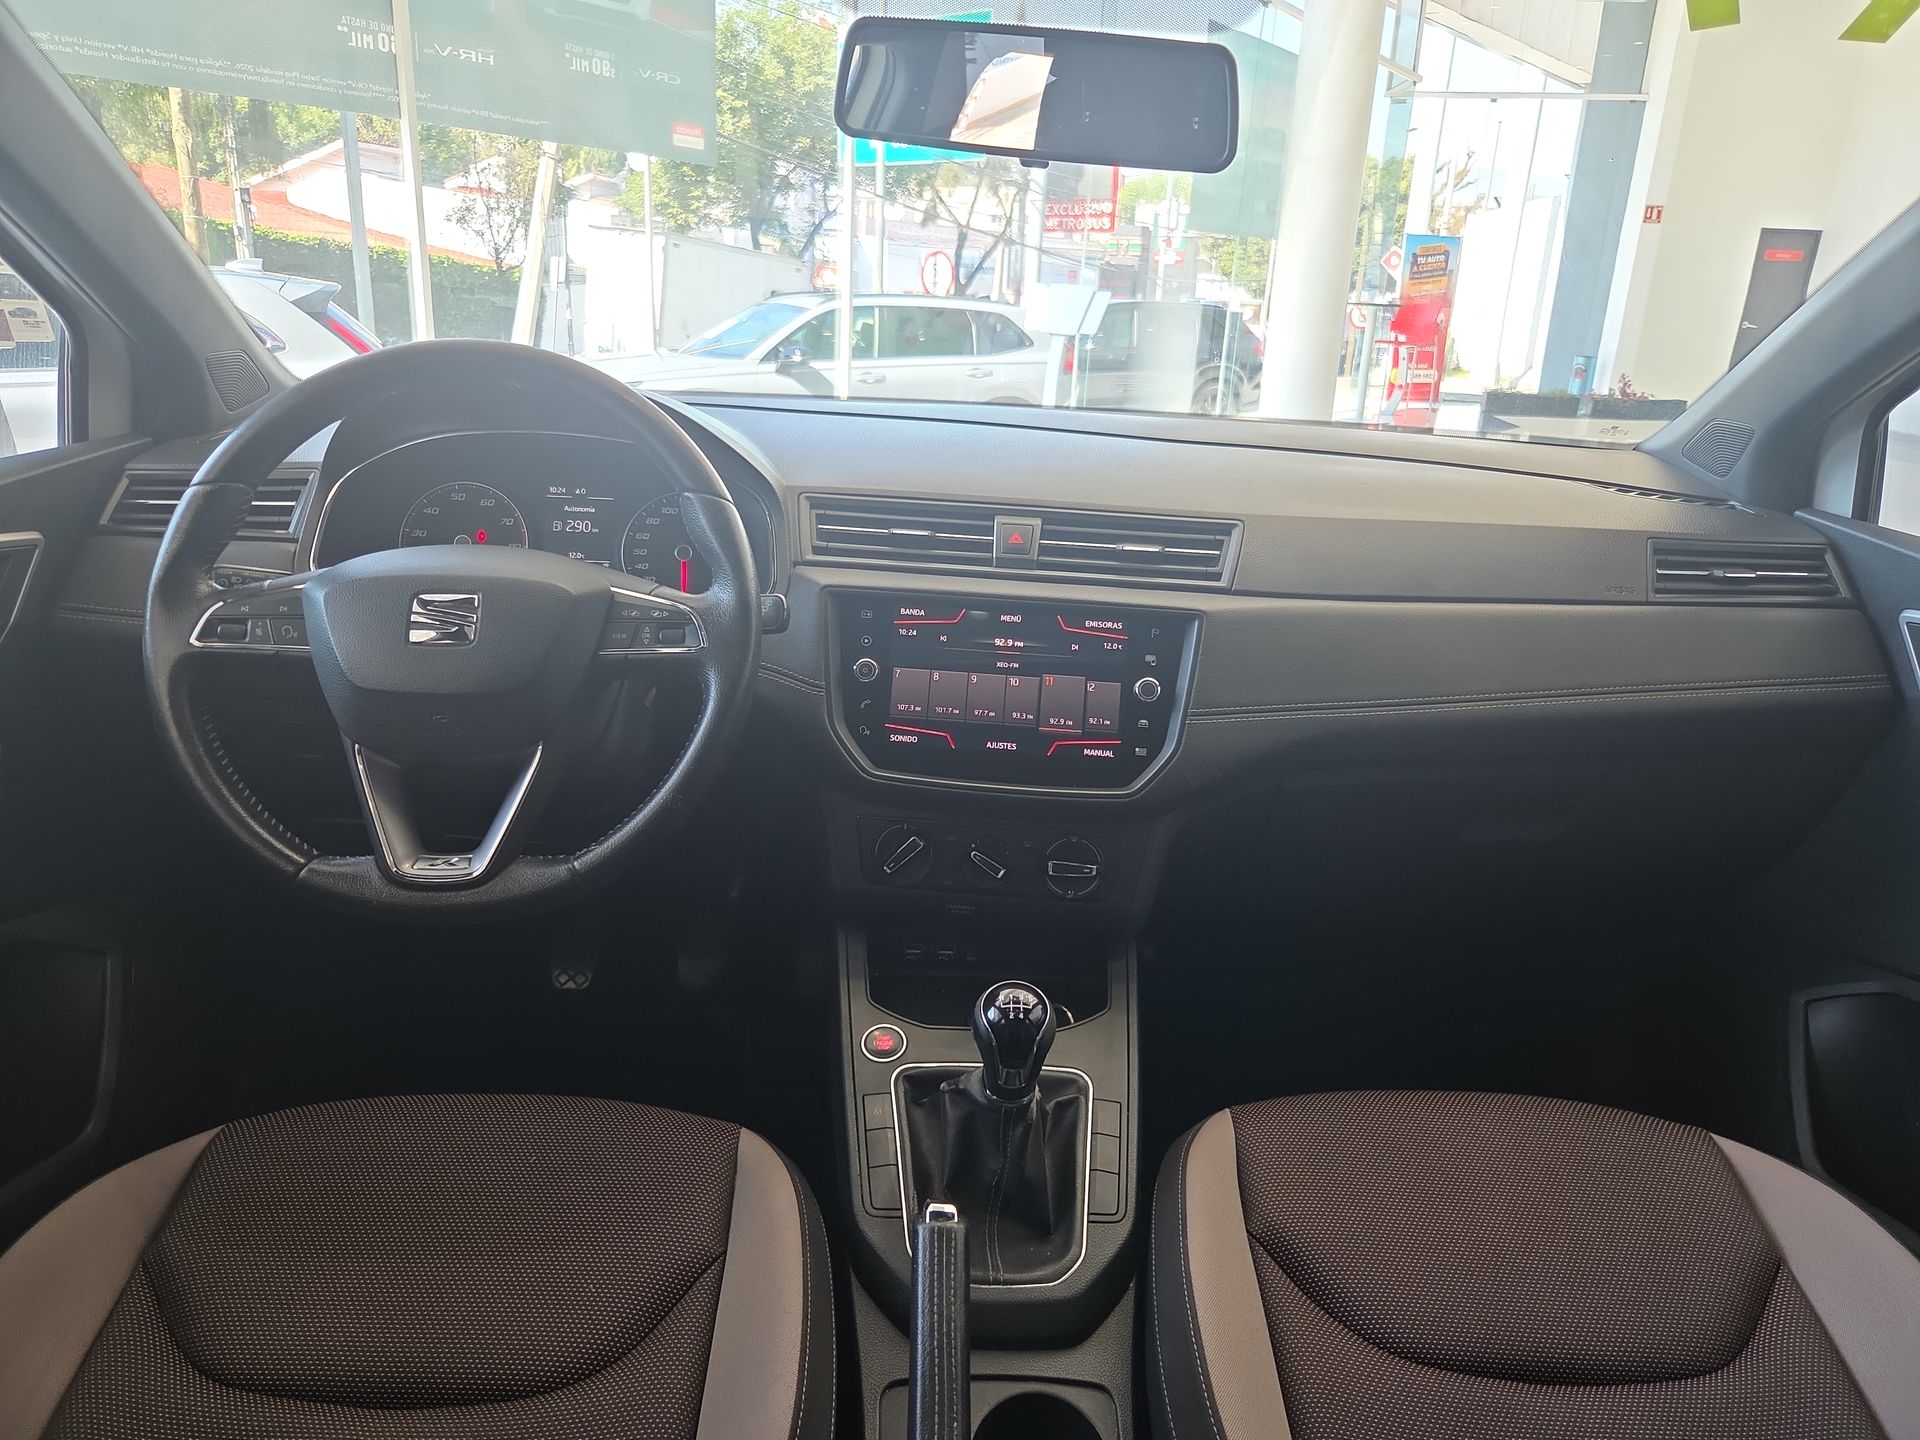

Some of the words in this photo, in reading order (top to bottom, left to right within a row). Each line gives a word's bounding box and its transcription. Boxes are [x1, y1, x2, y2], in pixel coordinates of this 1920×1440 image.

[450, 493, 466, 501] 50
[480, 498, 495, 506] 60
[423, 507, 440, 515] 40
[563, 505, 596, 513] Autonomía
[661, 507, 679, 515] 100
[645, 517, 661, 525] 80
[566, 519, 592, 533] 290
[411, 529, 428, 537] 30
[635, 532, 651, 540] 60
[633, 548, 648, 556] 50
[900, 607, 925, 616] BANDA
[1000, 613, 1022, 623] MENÚ
[1084, 620, 1123, 630] EMISORAS
[898, 628, 917, 637] 10:24
[994, 638, 1013, 647] 92.9
[895, 670, 901, 678] 7
[933, 672, 940, 681] 8
[971, 674, 977, 683] 9
[1009, 677, 1019, 687] 10
[1045, 676, 1054, 686] 11
[1086, 683, 1096, 692] 12
[897, 703, 915, 711] 107.3
[935, 706, 952, 714] 101.7
[974, 709, 989, 717] 97.7
[1012, 711, 1026, 719] 93.3
[1049, 717, 1065, 725] 92.9
[1088, 717, 1103, 725] 92.1
[889, 734, 918, 743] SONIDO
[986, 741, 1017, 750] AJUSTES
[1083, 748, 1115, 758] MANUAL
